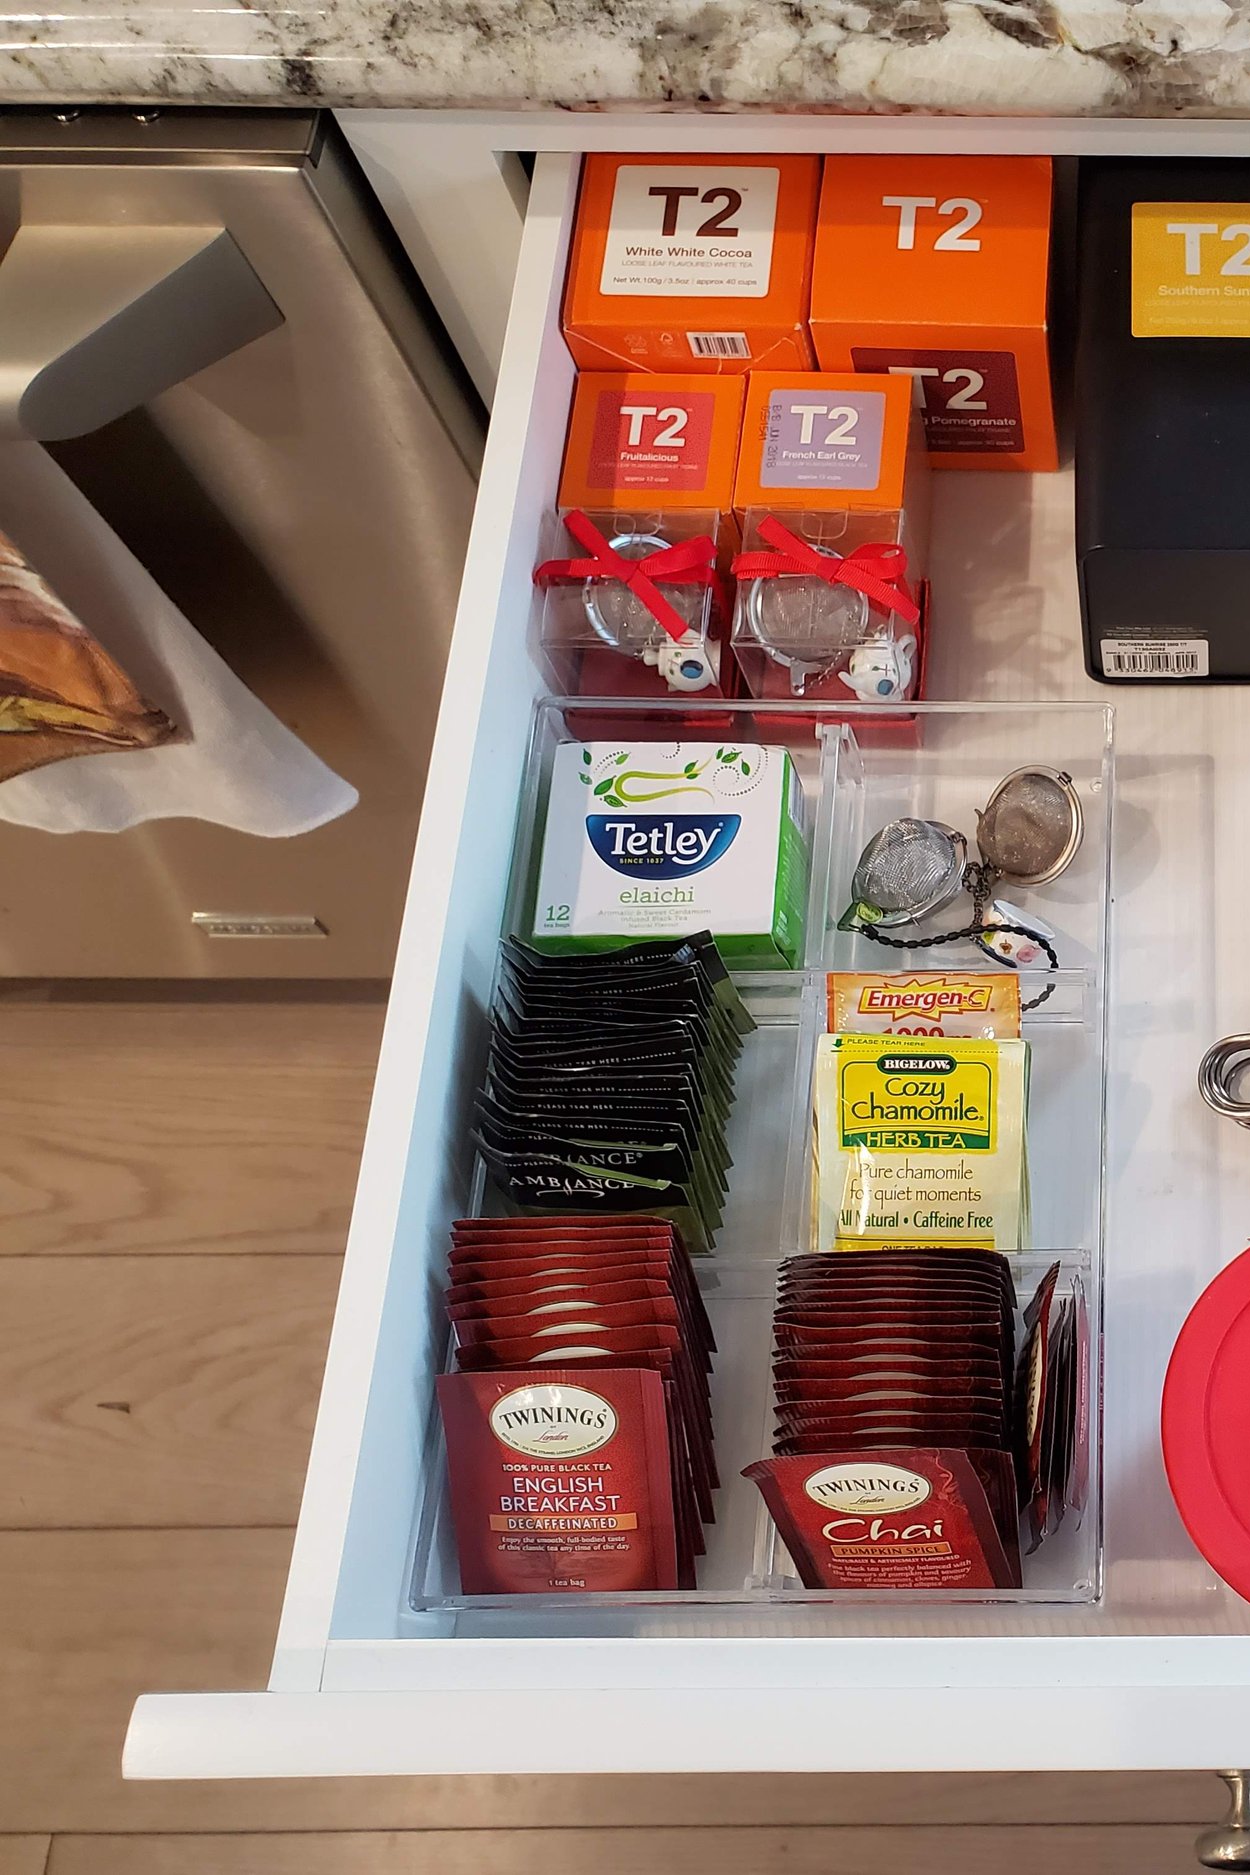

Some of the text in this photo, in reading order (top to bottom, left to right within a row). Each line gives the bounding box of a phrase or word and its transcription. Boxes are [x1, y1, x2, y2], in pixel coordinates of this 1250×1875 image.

[648, 187, 742, 237] T2
[882, 195, 982, 252] T2
[626, 247, 752, 258] White White Cocoa
[1158, 285, 1220, 297] Southern
[888, 366, 987, 410] T2
[620, 406, 688, 447] T2
[791, 406, 859, 446] T2
[932, 416, 1017, 427] Pomegranate
[621, 452, 679, 462] Fruitalicious
[782, 451, 861, 462] French Earl Grey
[605, 822, 722, 865] Tetley
[620, 886, 694, 904] elaichi
[546, 904, 570, 921] 12
[867, 989, 986, 1012] Emergen-C
[599, 1057, 620, 1065] HERE
[884, 1059, 950, 1070] BIGELOW
[885, 1078, 945, 1106] Cozy
[851, 1092, 978, 1122] Chamomile
[867, 1132, 966, 1149] HERB TEA
[859, 1158, 974, 1180] Pure chamomile
[874, 1184, 913, 1210] quiet
[915, 1187, 982, 1201] moments
[840, 1209, 852, 1226] All
[913, 1210, 965, 1228] Caffeine
[967, 1211, 994, 1228] Free
[499, 1406, 607, 1430] TWININGS
[532, 1430, 569, 1444] London
[502, 1463, 613, 1472] 100% PURE BLACK TEA
[513, 1477, 604, 1494] ENGLISH
[812, 1479, 920, 1497] TWININGS
[500, 1495, 621, 1513] BREAKFAST
[849, 1496, 886, 1505] London
[508, 1517, 618, 1530] DECAFFEINATED
[822, 1518, 944, 1542] Chai
[502, 1536, 521, 1545] Enjoy
[523, 1536, 535, 1544] the
[537, 1536, 566, 1544] smooth,
[567, 1536, 606, 1544] full-bodied
[841, 1547, 902, 1556] PUMPKIN
[881, 1565, 915, 1573] perfectly
[916, 1563, 952, 1571] balanced
[953, 1559, 972, 1569] with
[940, 1567, 972, 1576] savoury
[570, 1579, 585, 1587] bag
